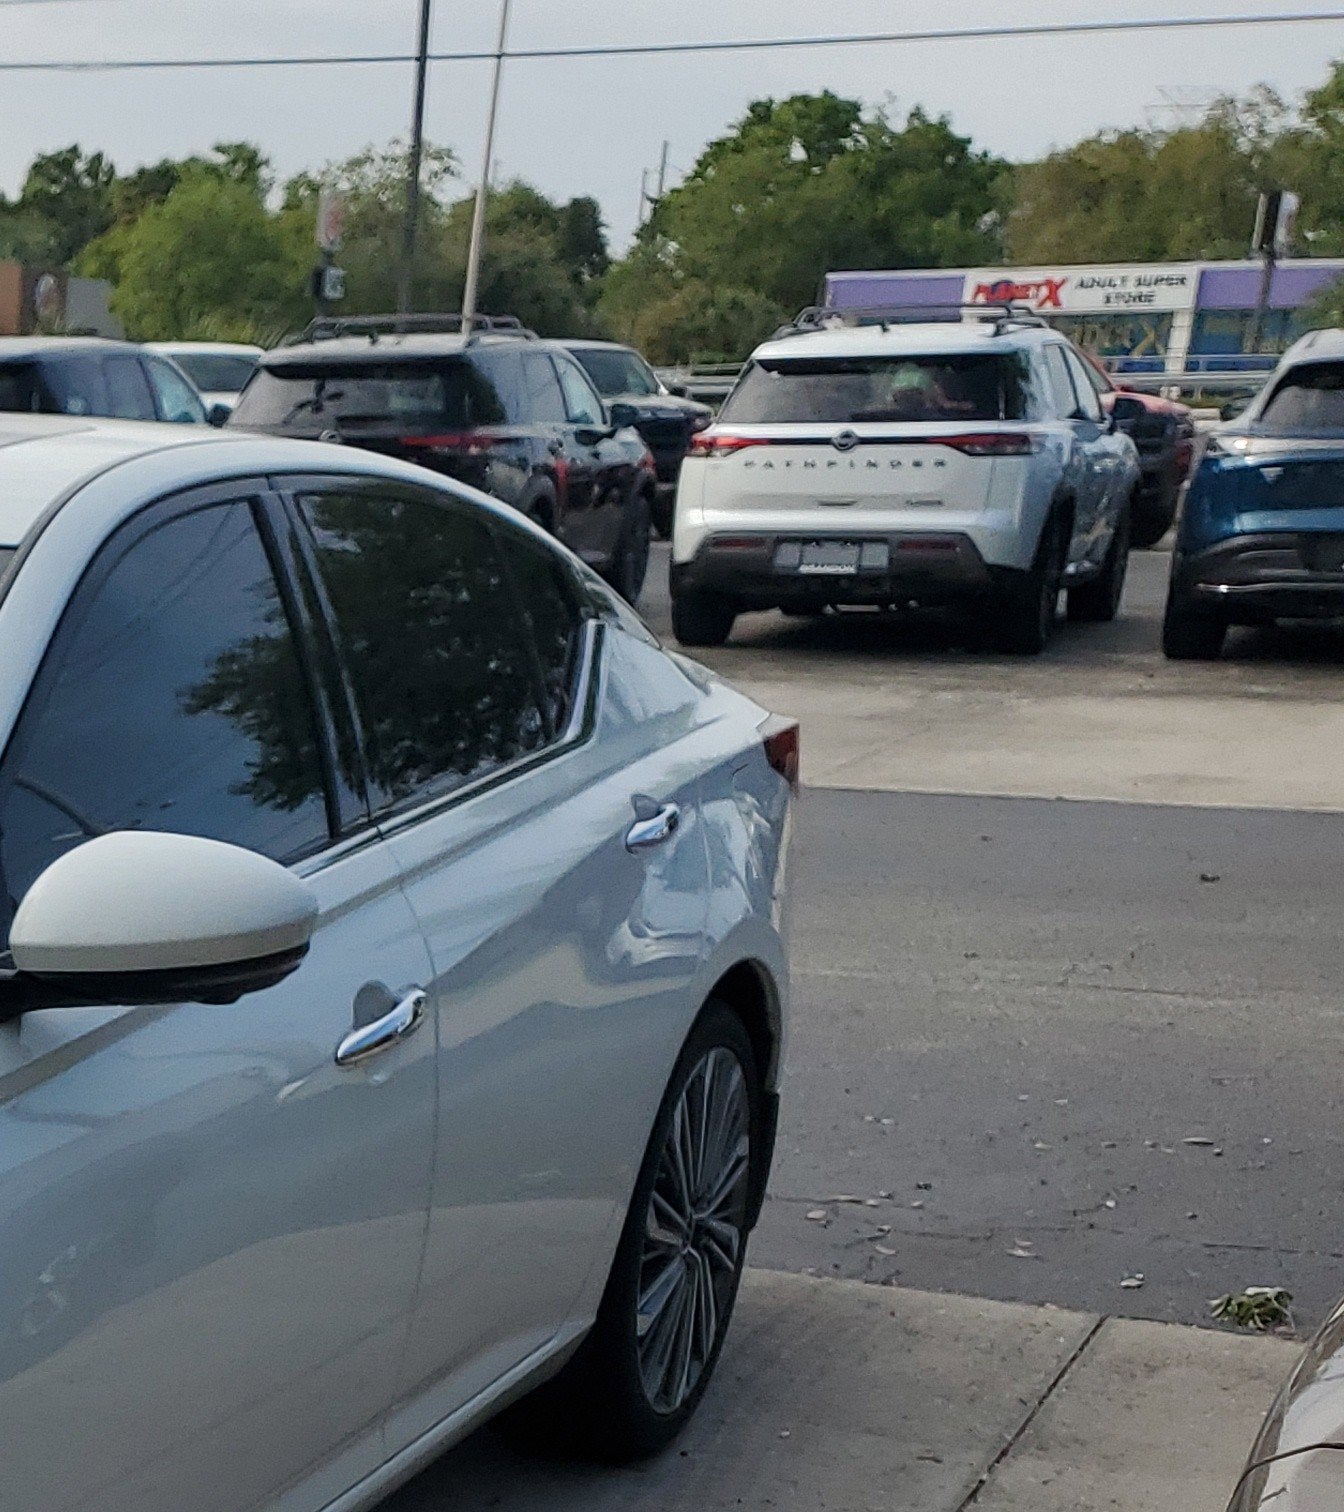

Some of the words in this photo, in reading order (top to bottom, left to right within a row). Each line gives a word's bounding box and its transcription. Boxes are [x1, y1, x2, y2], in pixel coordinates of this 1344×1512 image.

[1075, 275, 1128, 289] ADULT
[1135, 273, 1187, 287] SUPER
[744, 459, 947, 469] PATHFINDER
